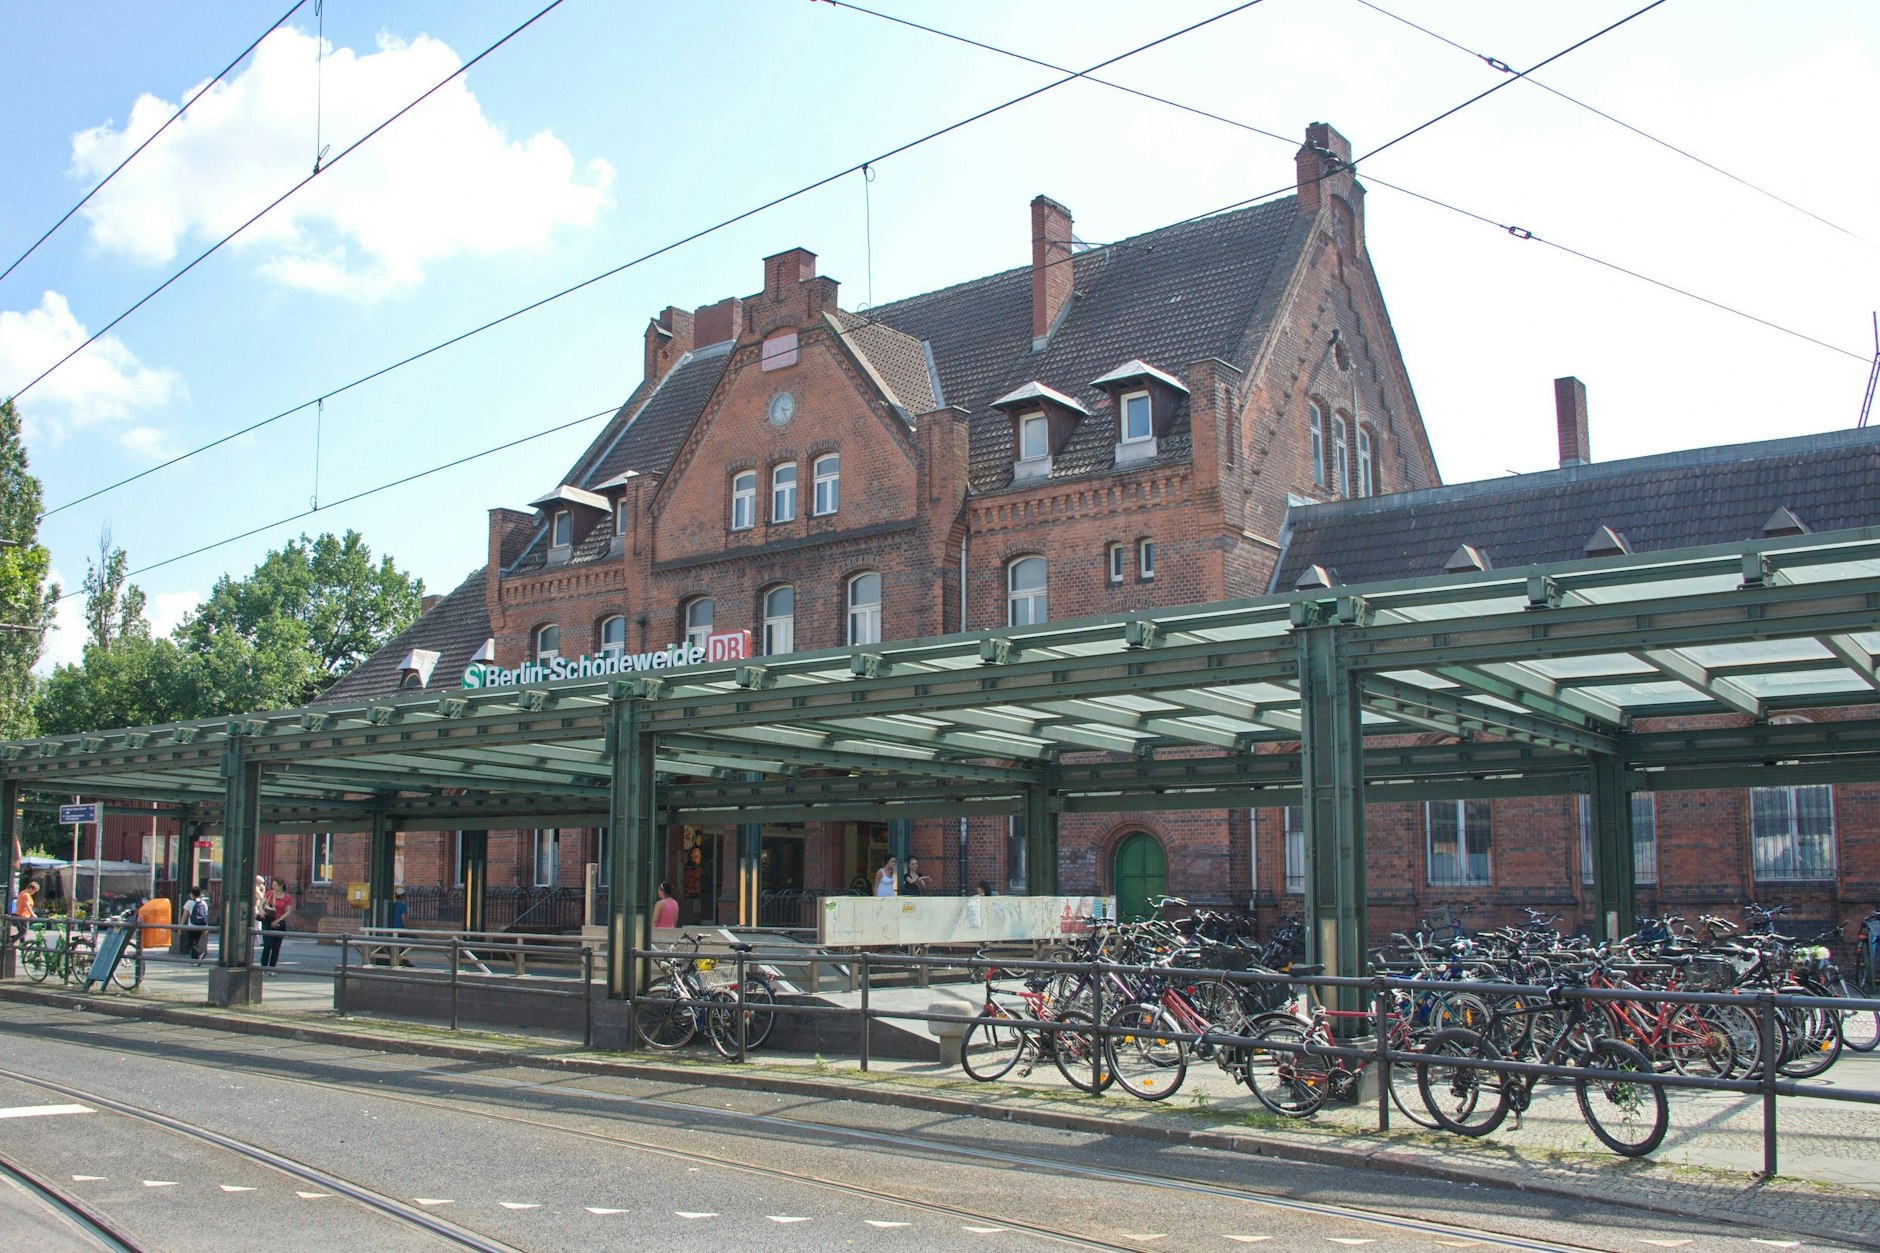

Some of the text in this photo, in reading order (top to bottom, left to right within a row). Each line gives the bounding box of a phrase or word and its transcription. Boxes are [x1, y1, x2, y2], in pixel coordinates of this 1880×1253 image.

[464, 637, 740, 689] S Berlin-Schöneweide DB
